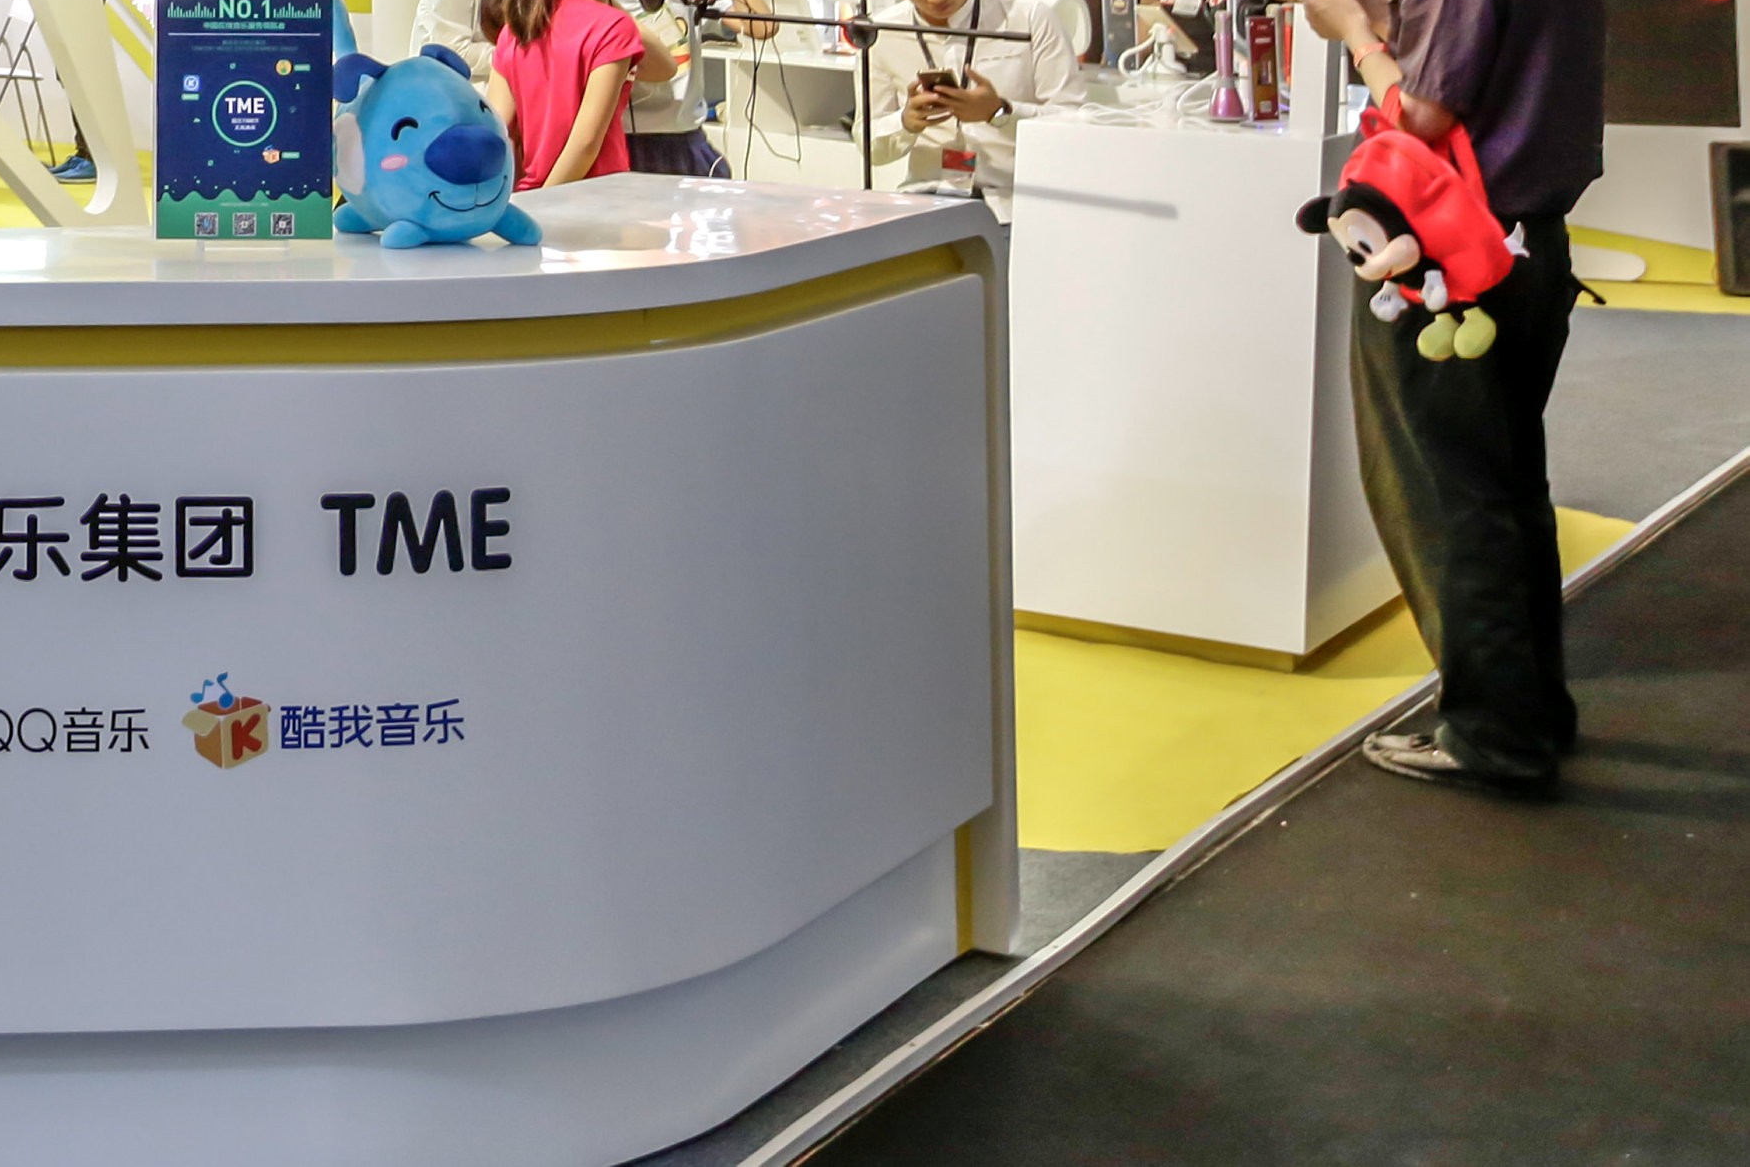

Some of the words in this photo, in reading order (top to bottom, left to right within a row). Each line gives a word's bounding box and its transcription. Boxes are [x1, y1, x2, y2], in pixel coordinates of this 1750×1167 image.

[224, 97, 265, 114] TME
[320, 486, 513, 577] TME
[280, 698, 465, 750] 酷我音乐
